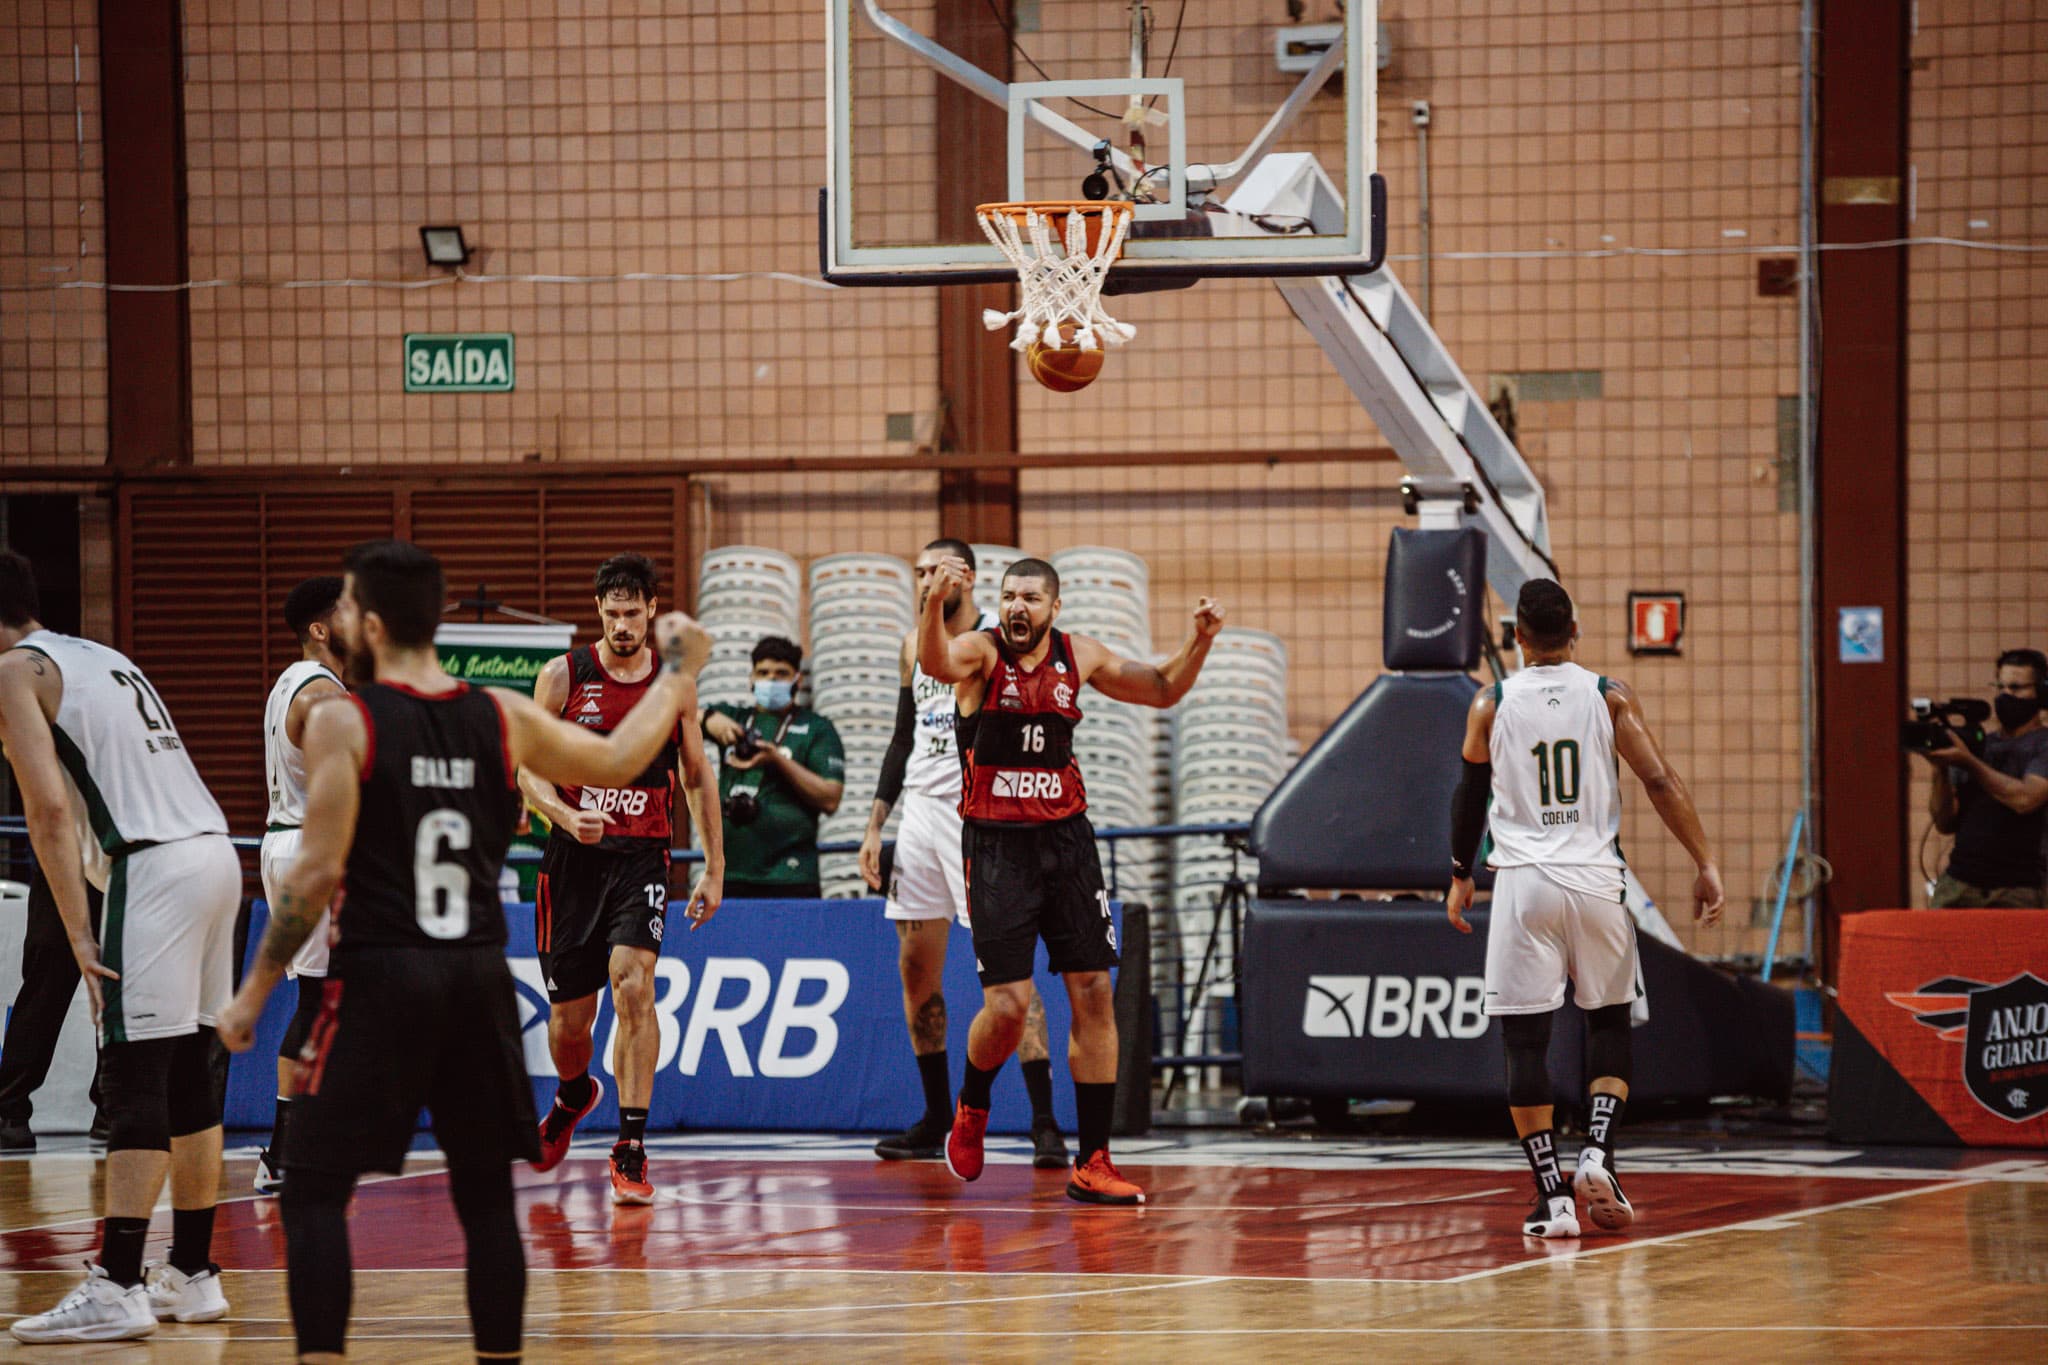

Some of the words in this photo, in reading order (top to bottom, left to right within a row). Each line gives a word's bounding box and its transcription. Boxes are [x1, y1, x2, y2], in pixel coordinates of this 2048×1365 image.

[411, 340, 508, 385] SAÍDA
[1022, 723, 1045, 753] 16
[1017, 771, 1062, 799] BRB
[1530, 739, 1580, 807] 10
[602, 788, 648, 816] BRB
[1541, 810, 1580, 826] COELHO
[413, 808, 472, 940] 6
[644, 883, 666, 911] 12
[602, 957, 850, 1078] BRB
[1369, 975, 1490, 1039] BRB
